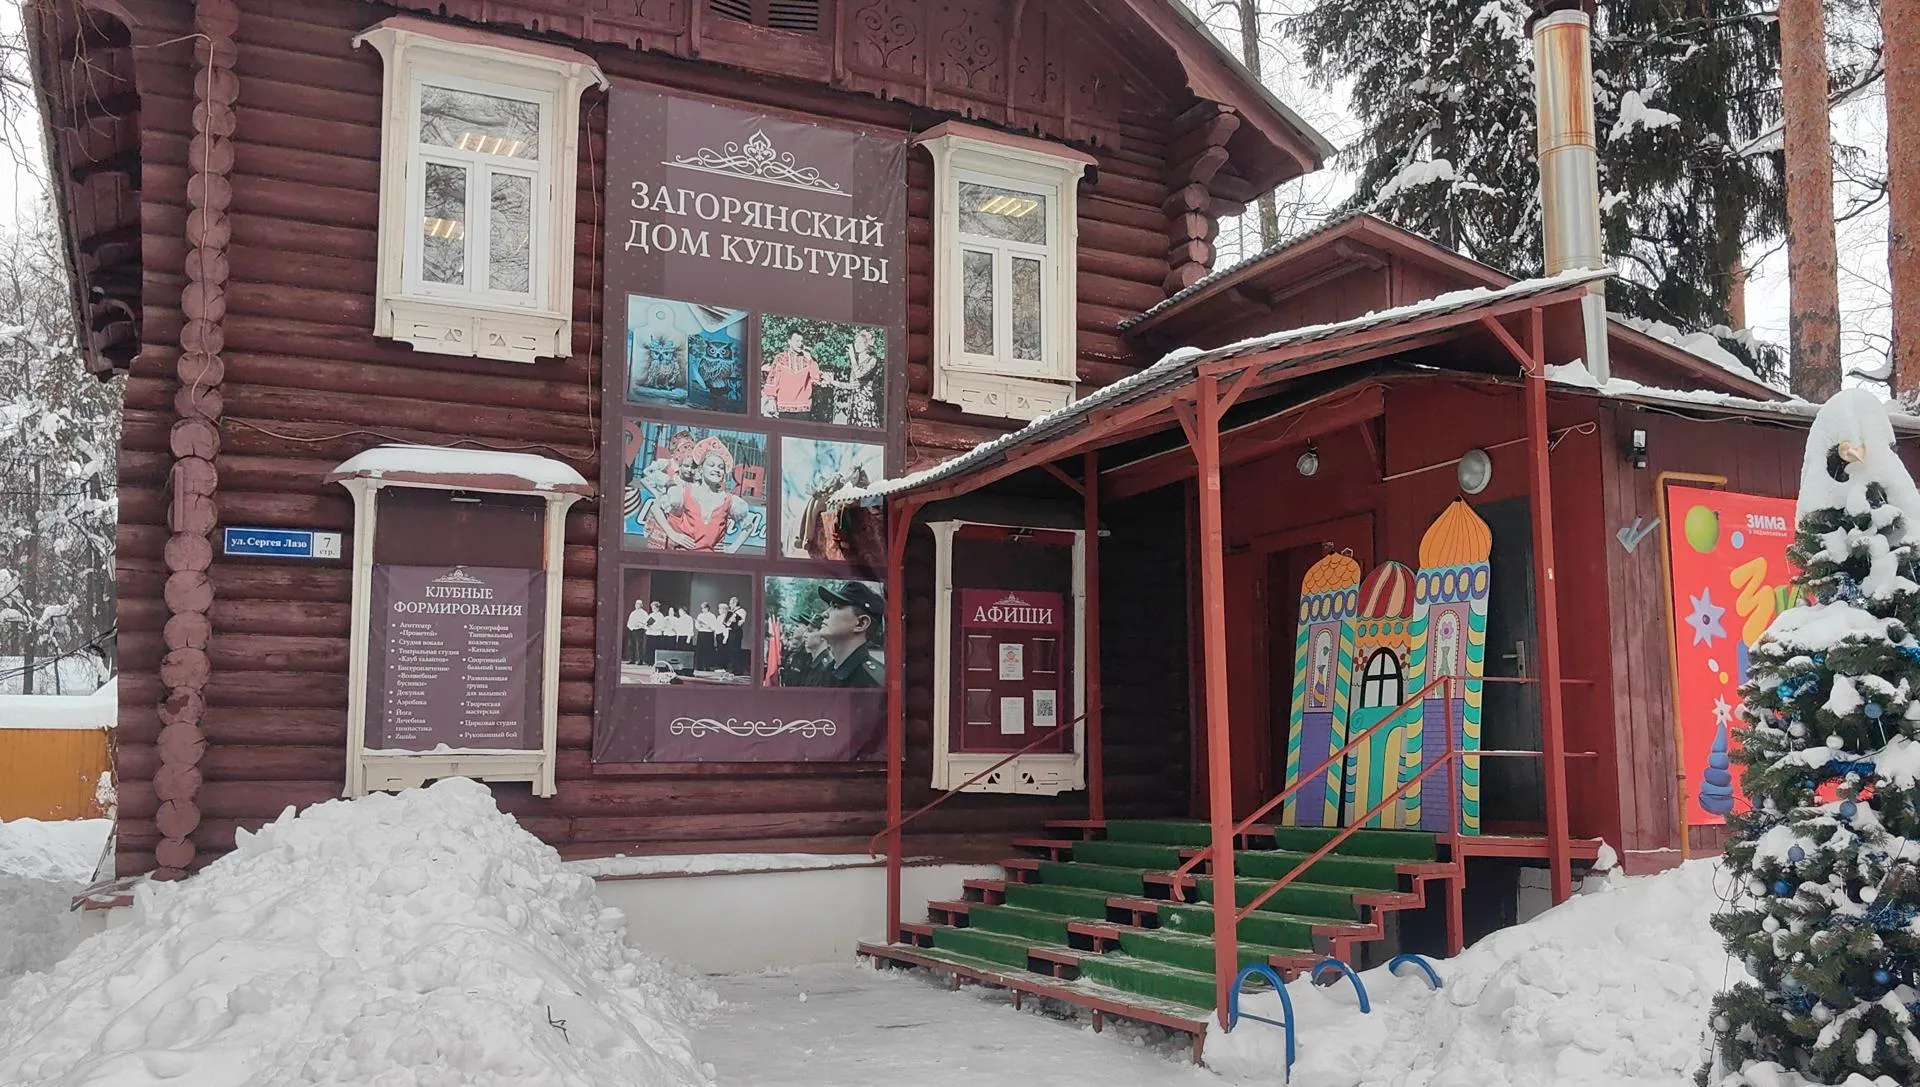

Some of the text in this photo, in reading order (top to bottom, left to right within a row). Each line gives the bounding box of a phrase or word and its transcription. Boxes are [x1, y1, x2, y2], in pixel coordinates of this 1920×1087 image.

[631, 182, 884, 247] ЗАГОРЯНСКИЙ
[625, 220, 889, 284] ДОМ КУЛЬТУРЫ
[231, 537, 307, 548] ул. Сергея Лазо
[323, 537, 331, 548] 7
[425, 586, 493, 599] КЛУБНЫЕ
[394, 601, 522, 616] ФОРМИРОВАНИЯ
[973, 606, 1053, 624] АФИШИ
